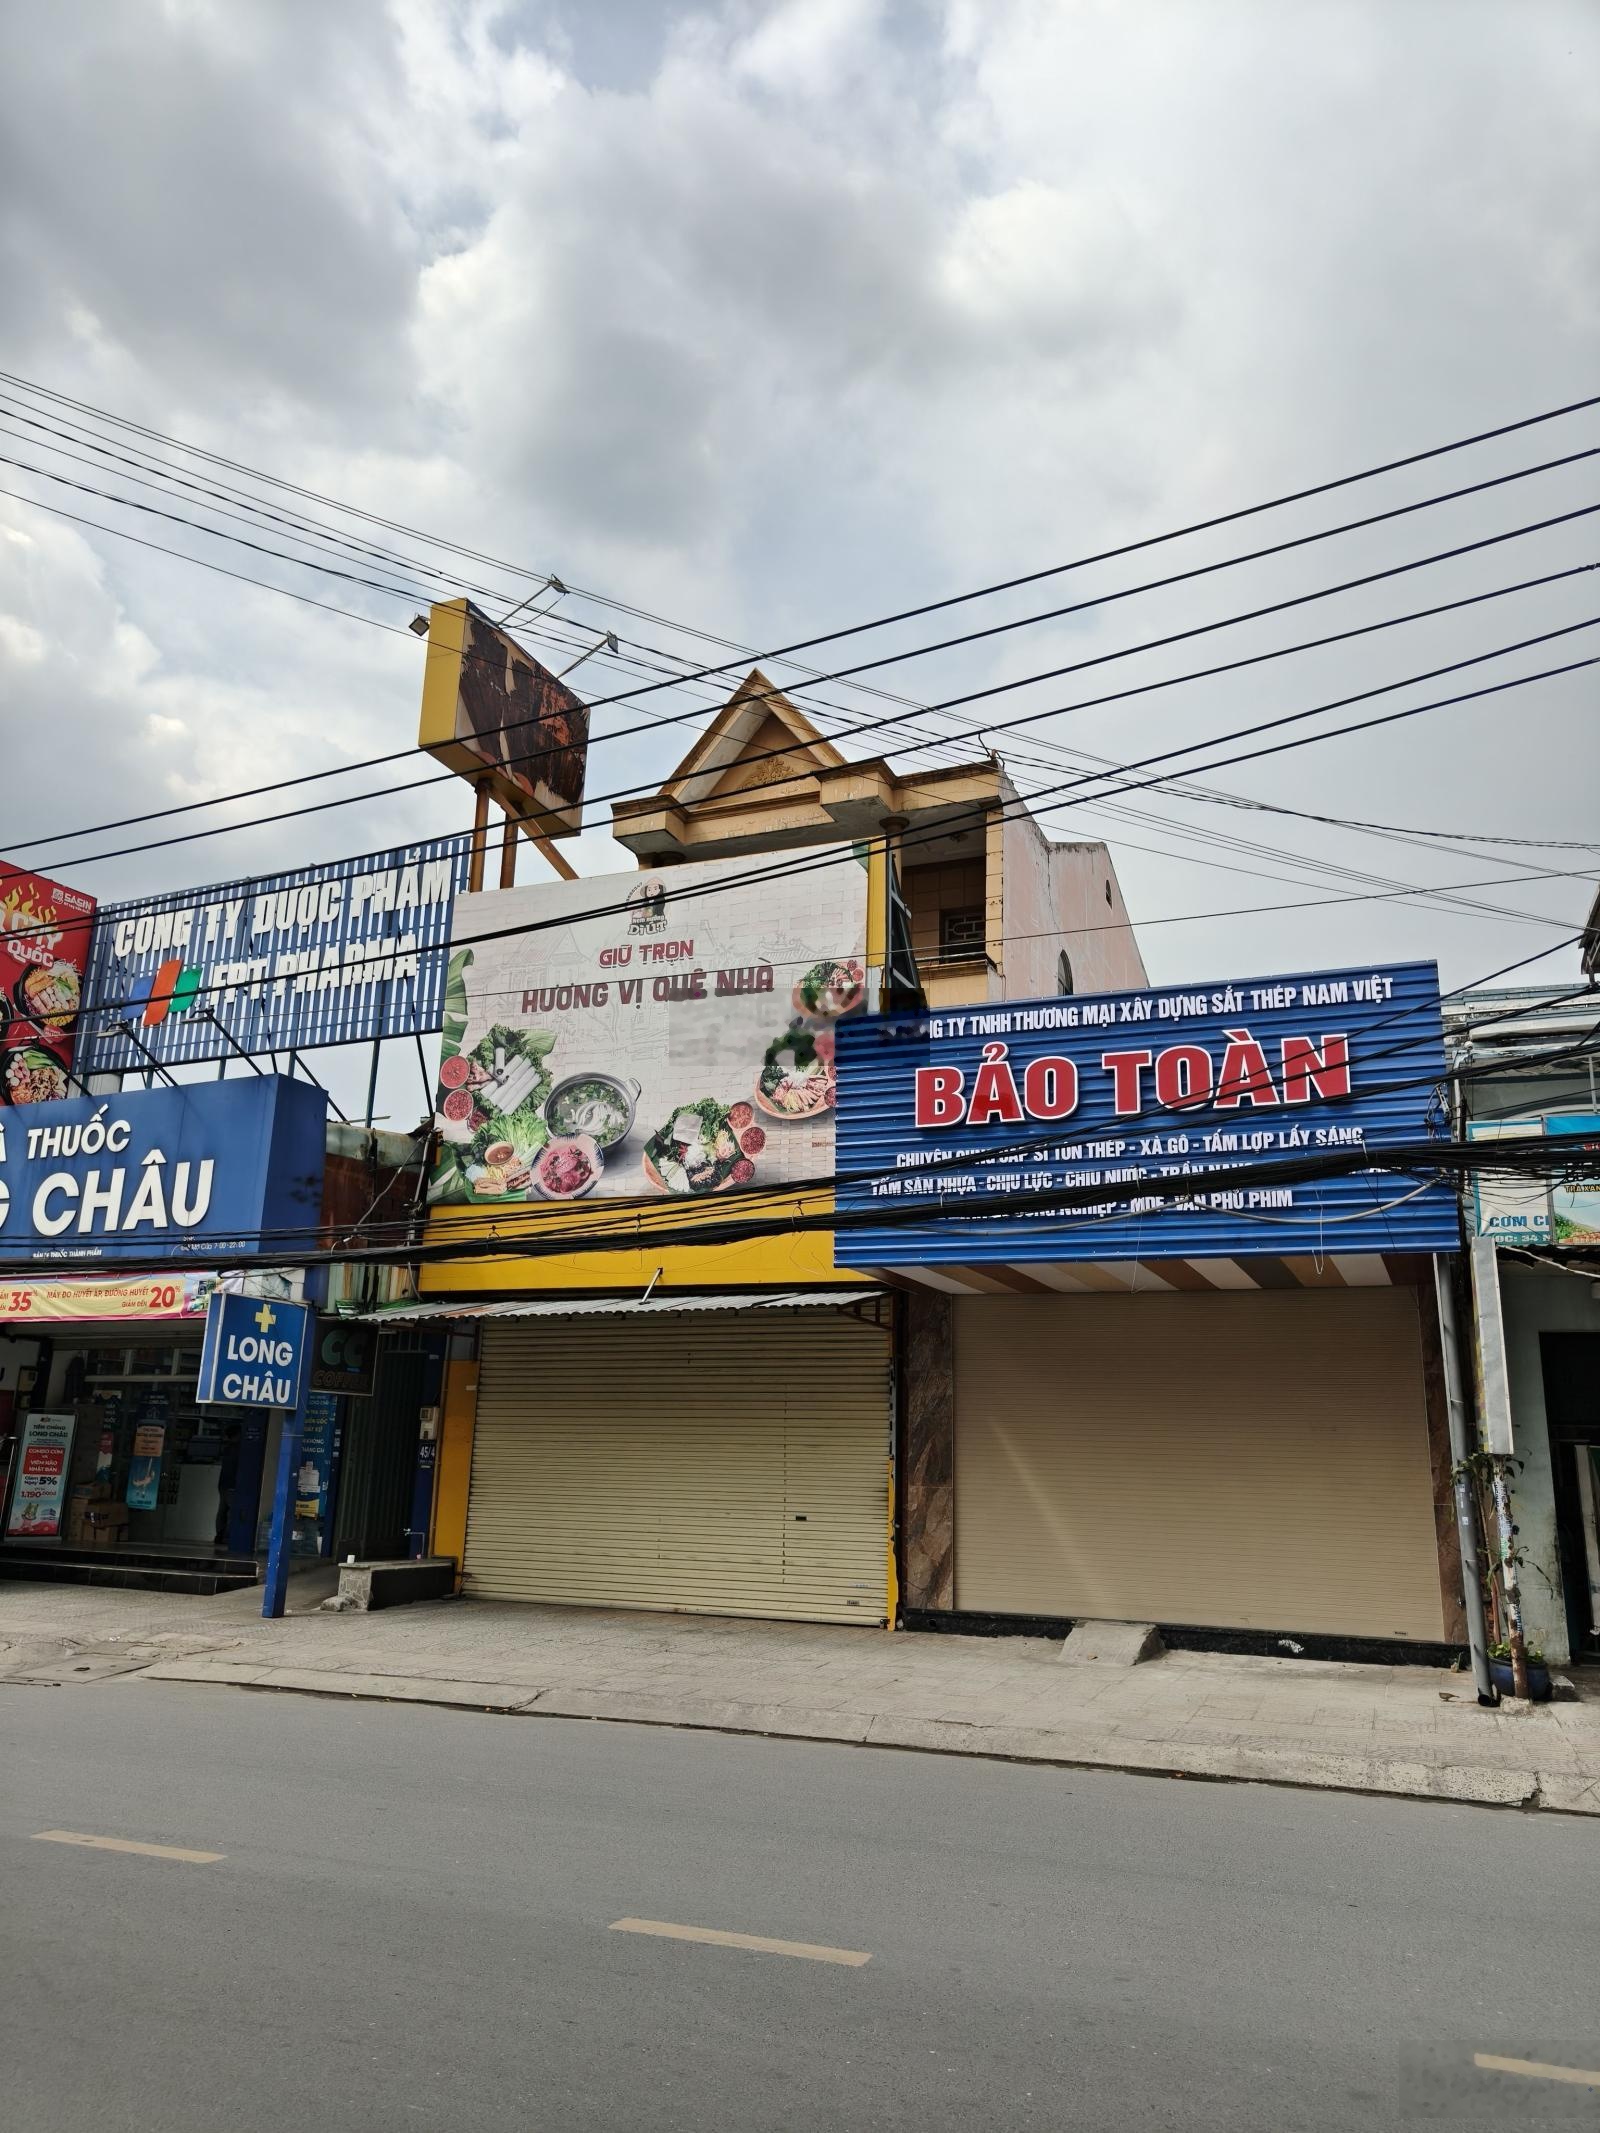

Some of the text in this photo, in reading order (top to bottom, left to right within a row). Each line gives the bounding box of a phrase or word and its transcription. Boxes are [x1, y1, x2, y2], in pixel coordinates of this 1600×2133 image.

[64, 892, 92, 911] SASIN
[115, 906, 195, 958] CÔNG
[205, 899, 244, 943] TY
[350, 847, 453, 918] PHẨM
[210, 933, 417, 1006] FPT PHARMA
[600, 939, 694, 968] GIỮ TRỌN
[618, 979, 644, 1009] VỊ
[652, 968, 708, 1002] QUÊ
[715, 956, 774, 998] NHÀ
[950, 1019, 966, 1037] TY
[970, 1013, 1012, 1035] TNHH
[1014, 1006, 1079, 1031] THƯƠNG
[1082, 1003, 1115, 1028] MẠI
[1120, 996, 1153, 1021] XÂY
[1158, 993, 1208, 1022] DỰNG
[1211, 985, 1245, 1013] SẮT
[1250, 985, 1296, 1010] THÉP
[1302, 982, 1349, 1006] NAM
[1352, 974, 1394, 1004] VIỆT
[914, 1028, 1352, 1128] BẢO TOÀN
[27, 1103, 132, 1160] THUỐC
[1086, 1139, 1126, 1159] THÉP
[1140, 1135, 1163, 1156] XÀ
[1202, 1128, 1238, 1153] TẤM
[1242, 1131, 1275, 1154] LỢP
[1279, 1123, 1311, 1149] LẤY
[1315, 1125, 1363, 1146] SÁNG
[32, 1149, 215, 1236] CHÂU
[936, 1175, 977, 1195] NHỰA
[986, 1174, 1021, 1193] CHỊU
[1024, 1171, 1053, 1192] LỰC
[1249, 1190, 1293, 1209] PHIM
[61, 1291, 72, 1299] ĐO
[73, 1288, 93, 1298] HUYẾT
[104, 1288, 128, 1297] ĐƯỜNG
[129, 1287, 149, 1296] HUYẾT
[227, 1334, 293, 1367] LONG
[222, 1370, 291, 1404] CHÂU
[39, 1476, 58, 1486] 5%
